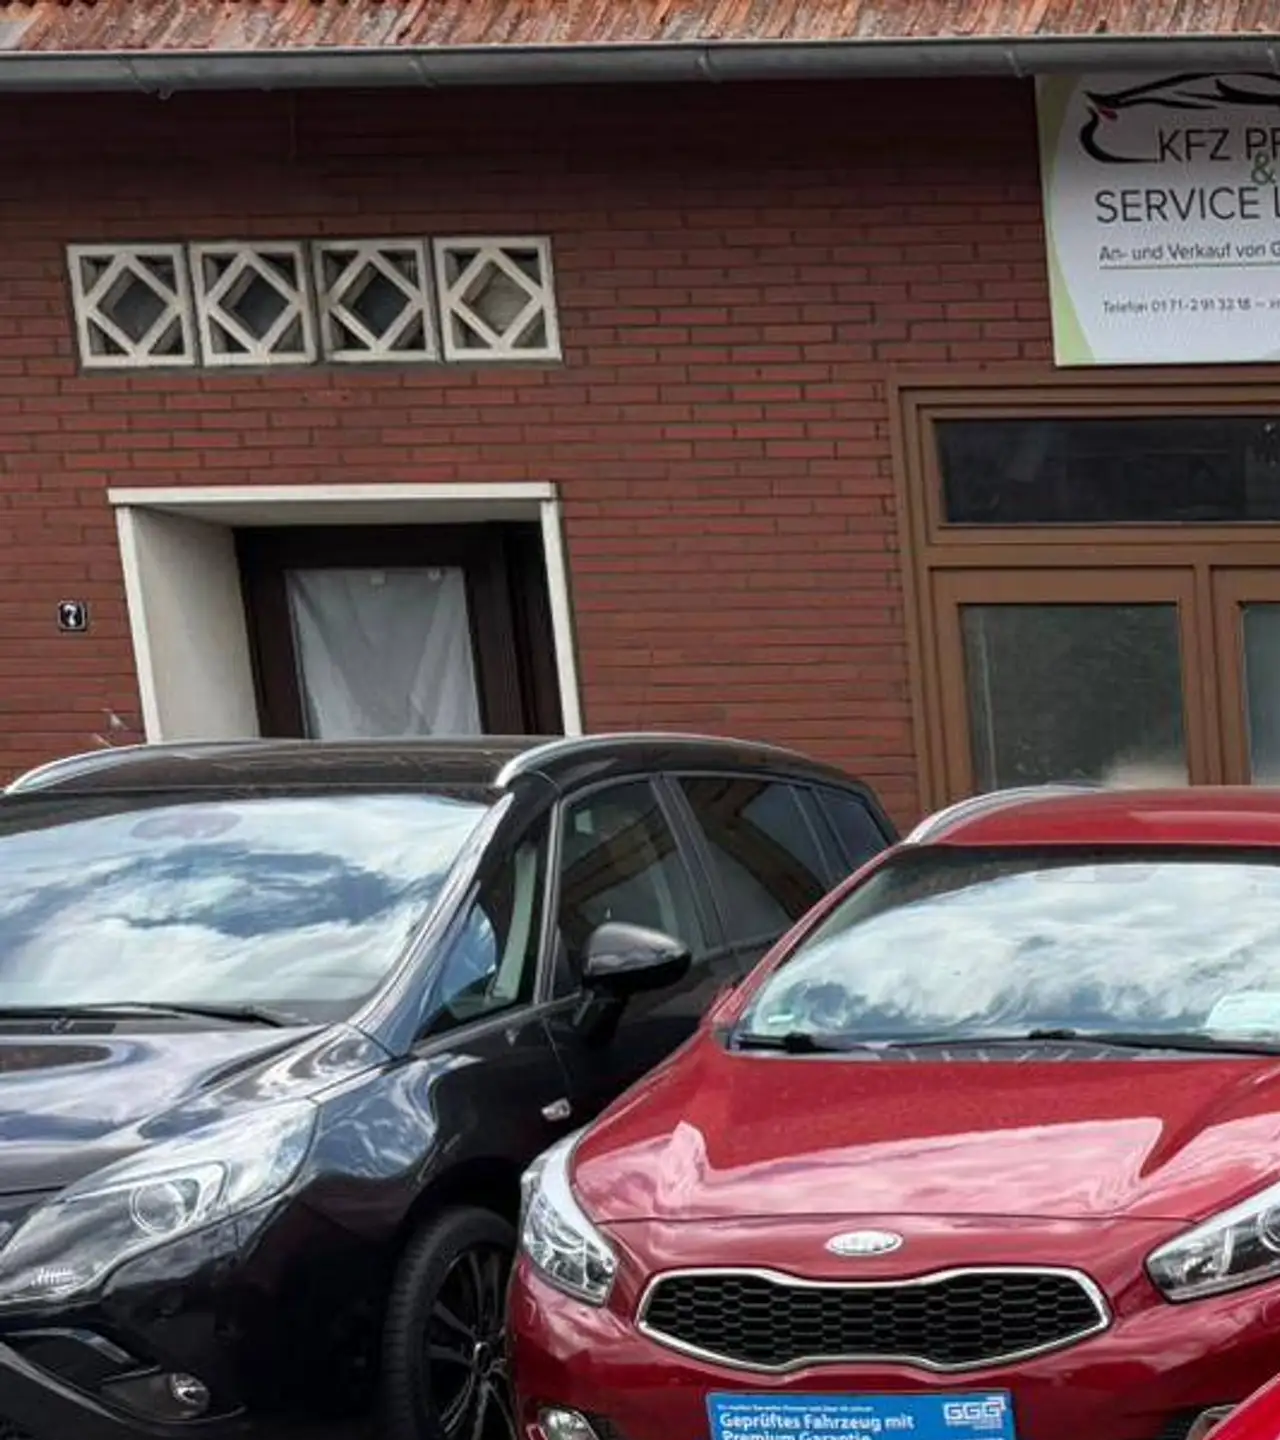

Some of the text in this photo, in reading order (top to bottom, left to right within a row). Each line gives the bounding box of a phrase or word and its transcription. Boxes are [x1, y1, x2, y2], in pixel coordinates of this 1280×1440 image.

[1158, 127, 1232, 163] KFZ
[1250, 150, 1277, 186] &
[1095, 186, 1261, 223] SERVICE
[1131, 244, 1164, 261] und
[1166, 240, 1231, 261] Verkauf
[1235, 243, 1267, 258] von
[719, 1412, 916, 1433] Geprüftes Fahrzeug mit
